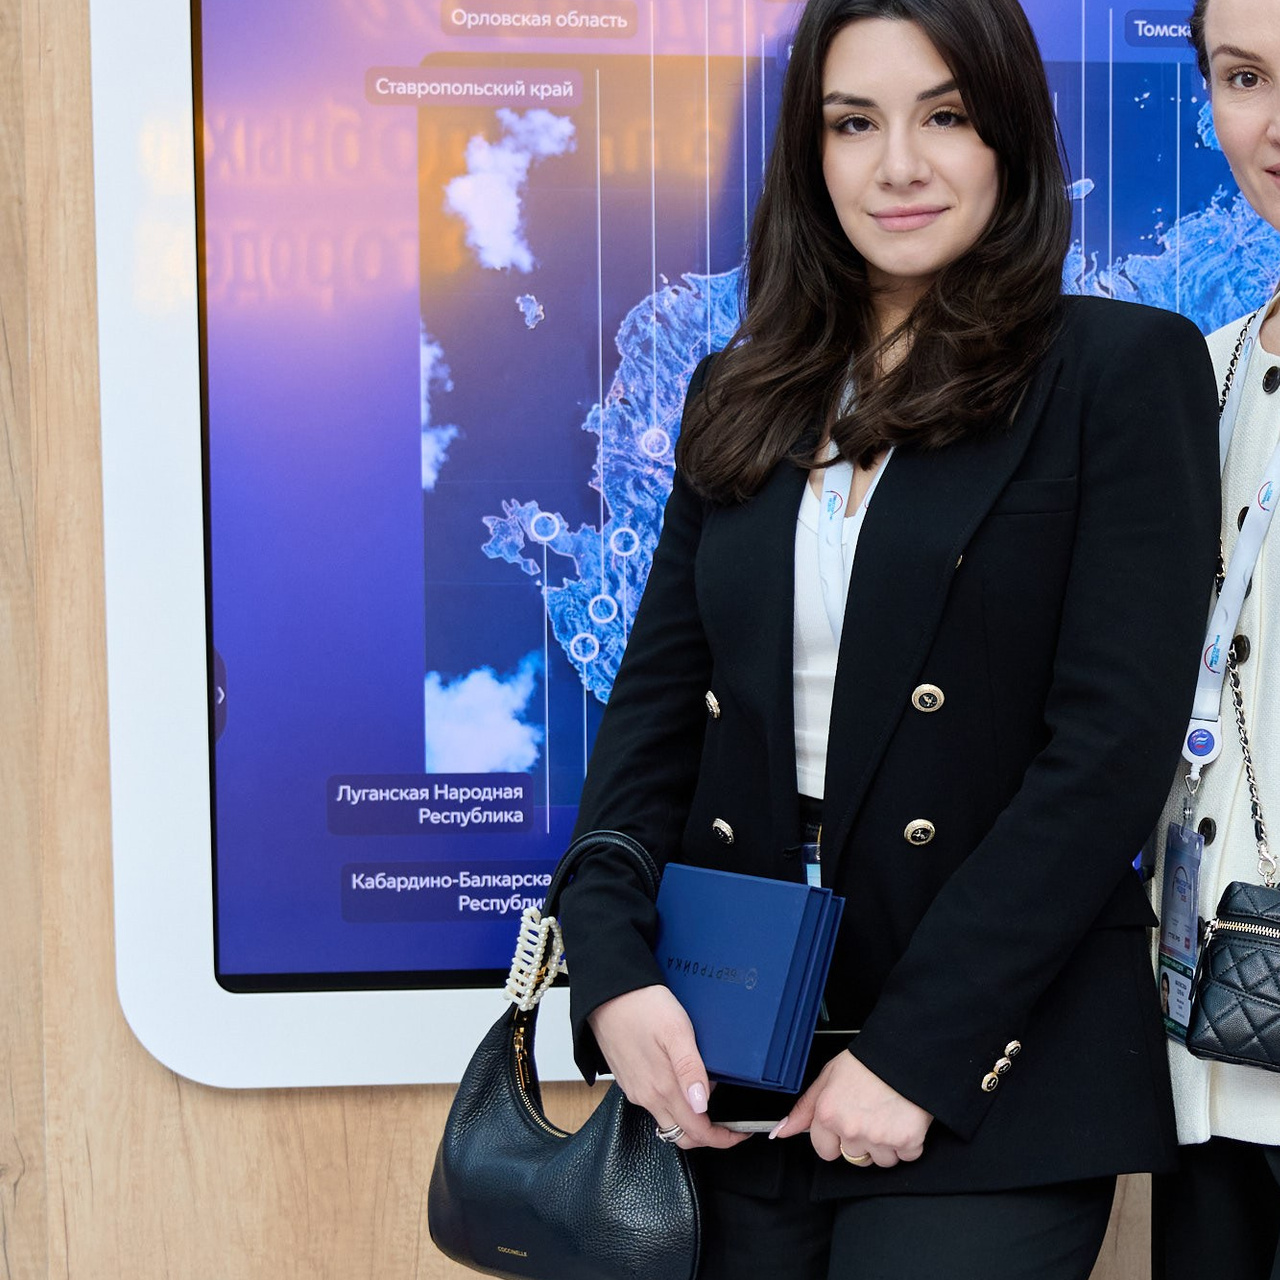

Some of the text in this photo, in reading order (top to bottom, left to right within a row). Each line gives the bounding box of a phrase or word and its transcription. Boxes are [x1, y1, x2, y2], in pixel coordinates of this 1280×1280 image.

[451, 8, 628, 29] Орловская область
[375, 77, 574, 101] Ставропольский край
[336, 784, 524, 806] Луганская Народная
[418, 806, 524, 828] Республика
[458, 893, 546, 915] Республи
